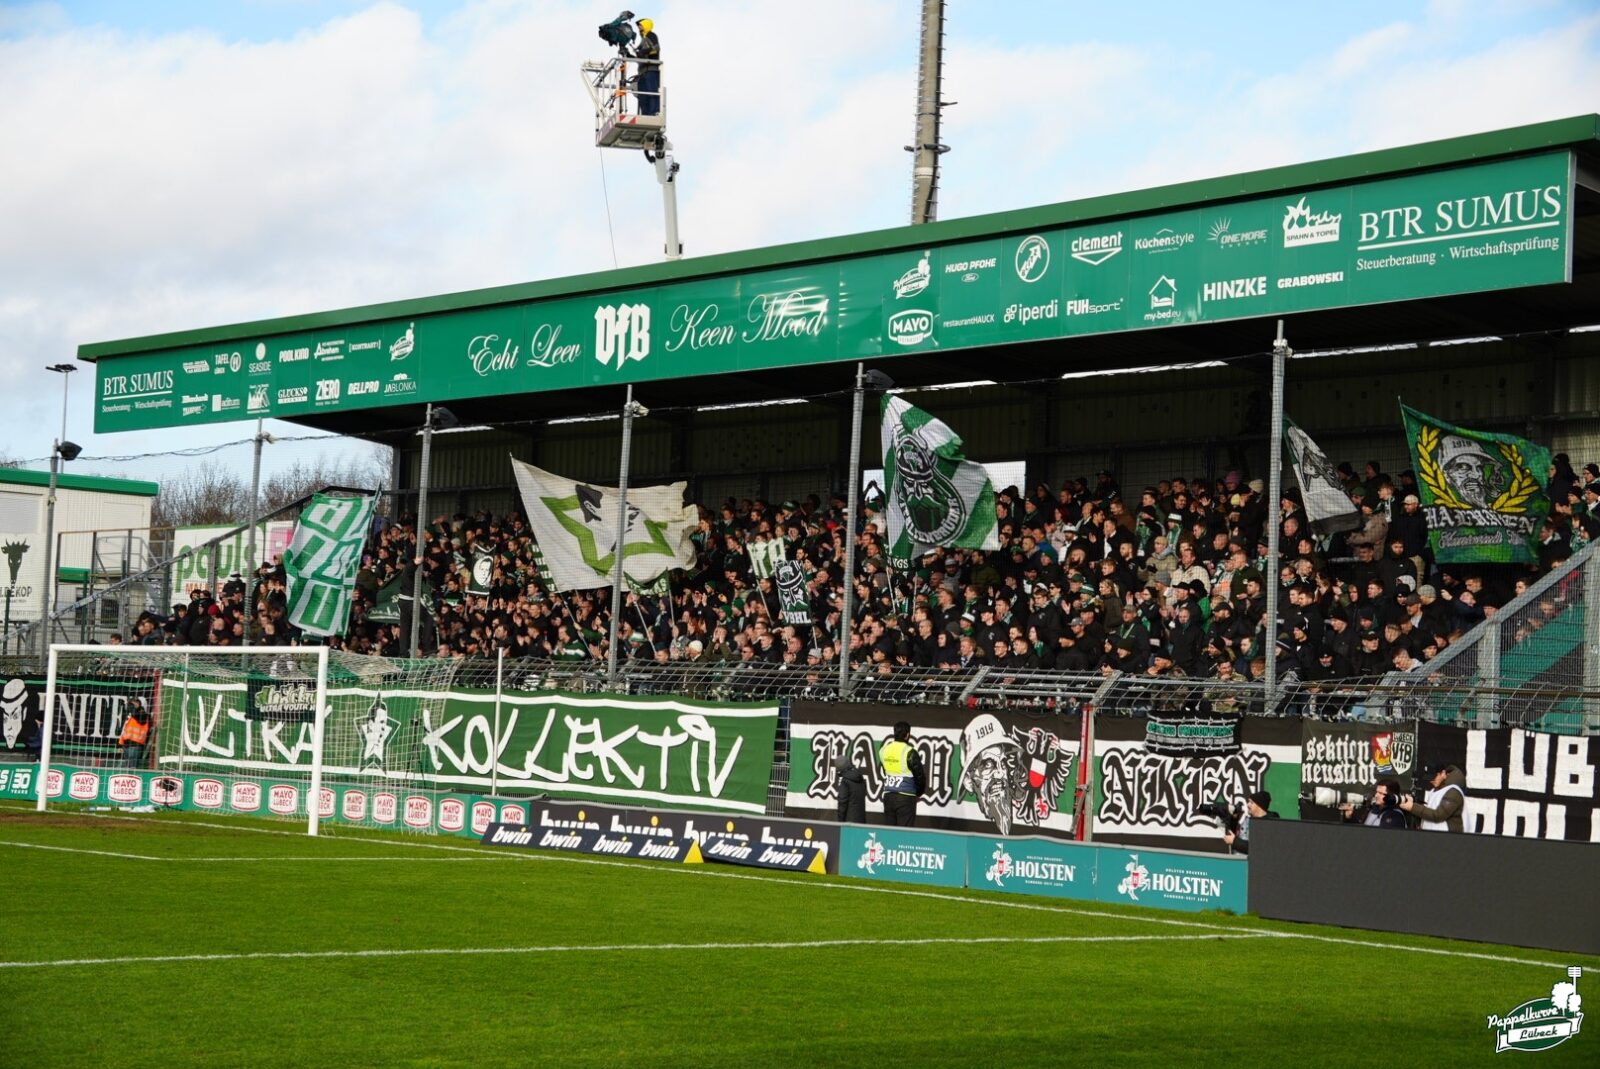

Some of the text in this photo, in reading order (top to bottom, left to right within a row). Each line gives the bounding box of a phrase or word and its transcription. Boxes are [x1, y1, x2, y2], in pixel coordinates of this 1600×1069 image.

[1359, 185, 1561, 242] BTR SUMUS
[1071, 231, 1123, 252] clement
[1135, 232, 1194, 250] Küchenstyle
[1220, 229, 1268, 245] ONE MORE
[1287, 233, 1309, 242] SPAHN
[1356, 236, 1559, 271] Steuerberatung Wirtschaftsprüfung
[945, 257, 996, 274] HUGO PFOHE
[1203, 276, 1267, 301] HINZKE
[1277, 271, 1344, 289] GRABOWSKI
[1018, 300, 1058, 326] iperdi
[1067, 298, 1121, 316] FUHsport
[893, 317, 930, 334] MAYO
[943, 313, 995, 328] restaurantHAUCK
[467, 333, 519, 377] Echt
[594, 303, 651, 372] VfB
[664, 304, 737, 352] Keen
[741, 291, 829, 342] Mood
[248, 361, 272, 374] SEASIDE
[103, 370, 173, 396] BTR SUMUS
[348, 380, 379, 395] DELLPRO
[975, 722, 994, 740] 1919
[1391, 742, 1413, 763] VfB
[12, 773, 31, 789] 30
[75, 776, 95, 786] MAYO
[114, 779, 137, 788] MAYO
[198, 784, 219, 793] MAYO
[113, 787, 135, 795] LÜBECK
[197, 792, 218, 800] LÜBECK
[235, 787, 256, 797] MAYO
[273, 790, 294, 800] MAYO
[319, 793, 331, 803] AYO
[346, 795, 363, 805] MAYO
[377, 798, 393, 808] MAYO
[408, 801, 428, 811] MAYO
[443, 805, 460, 814] MAYO
[475, 808, 492, 818] MAYO
[504, 811, 521, 821] MAYO
[491, 826, 533, 845] bwin
[539, 829, 582, 849] bwin
[592, 835, 633, 854] bwin
[638, 839, 680, 859] bwin
[708, 840, 752, 859] bwin
[758, 846, 804, 866] bwin
[886, 849, 945, 870] HOLSTEN
[1015, 860, 1074, 882] HOLSTEN
[1152, 873, 1221, 897] HOLSTEN
